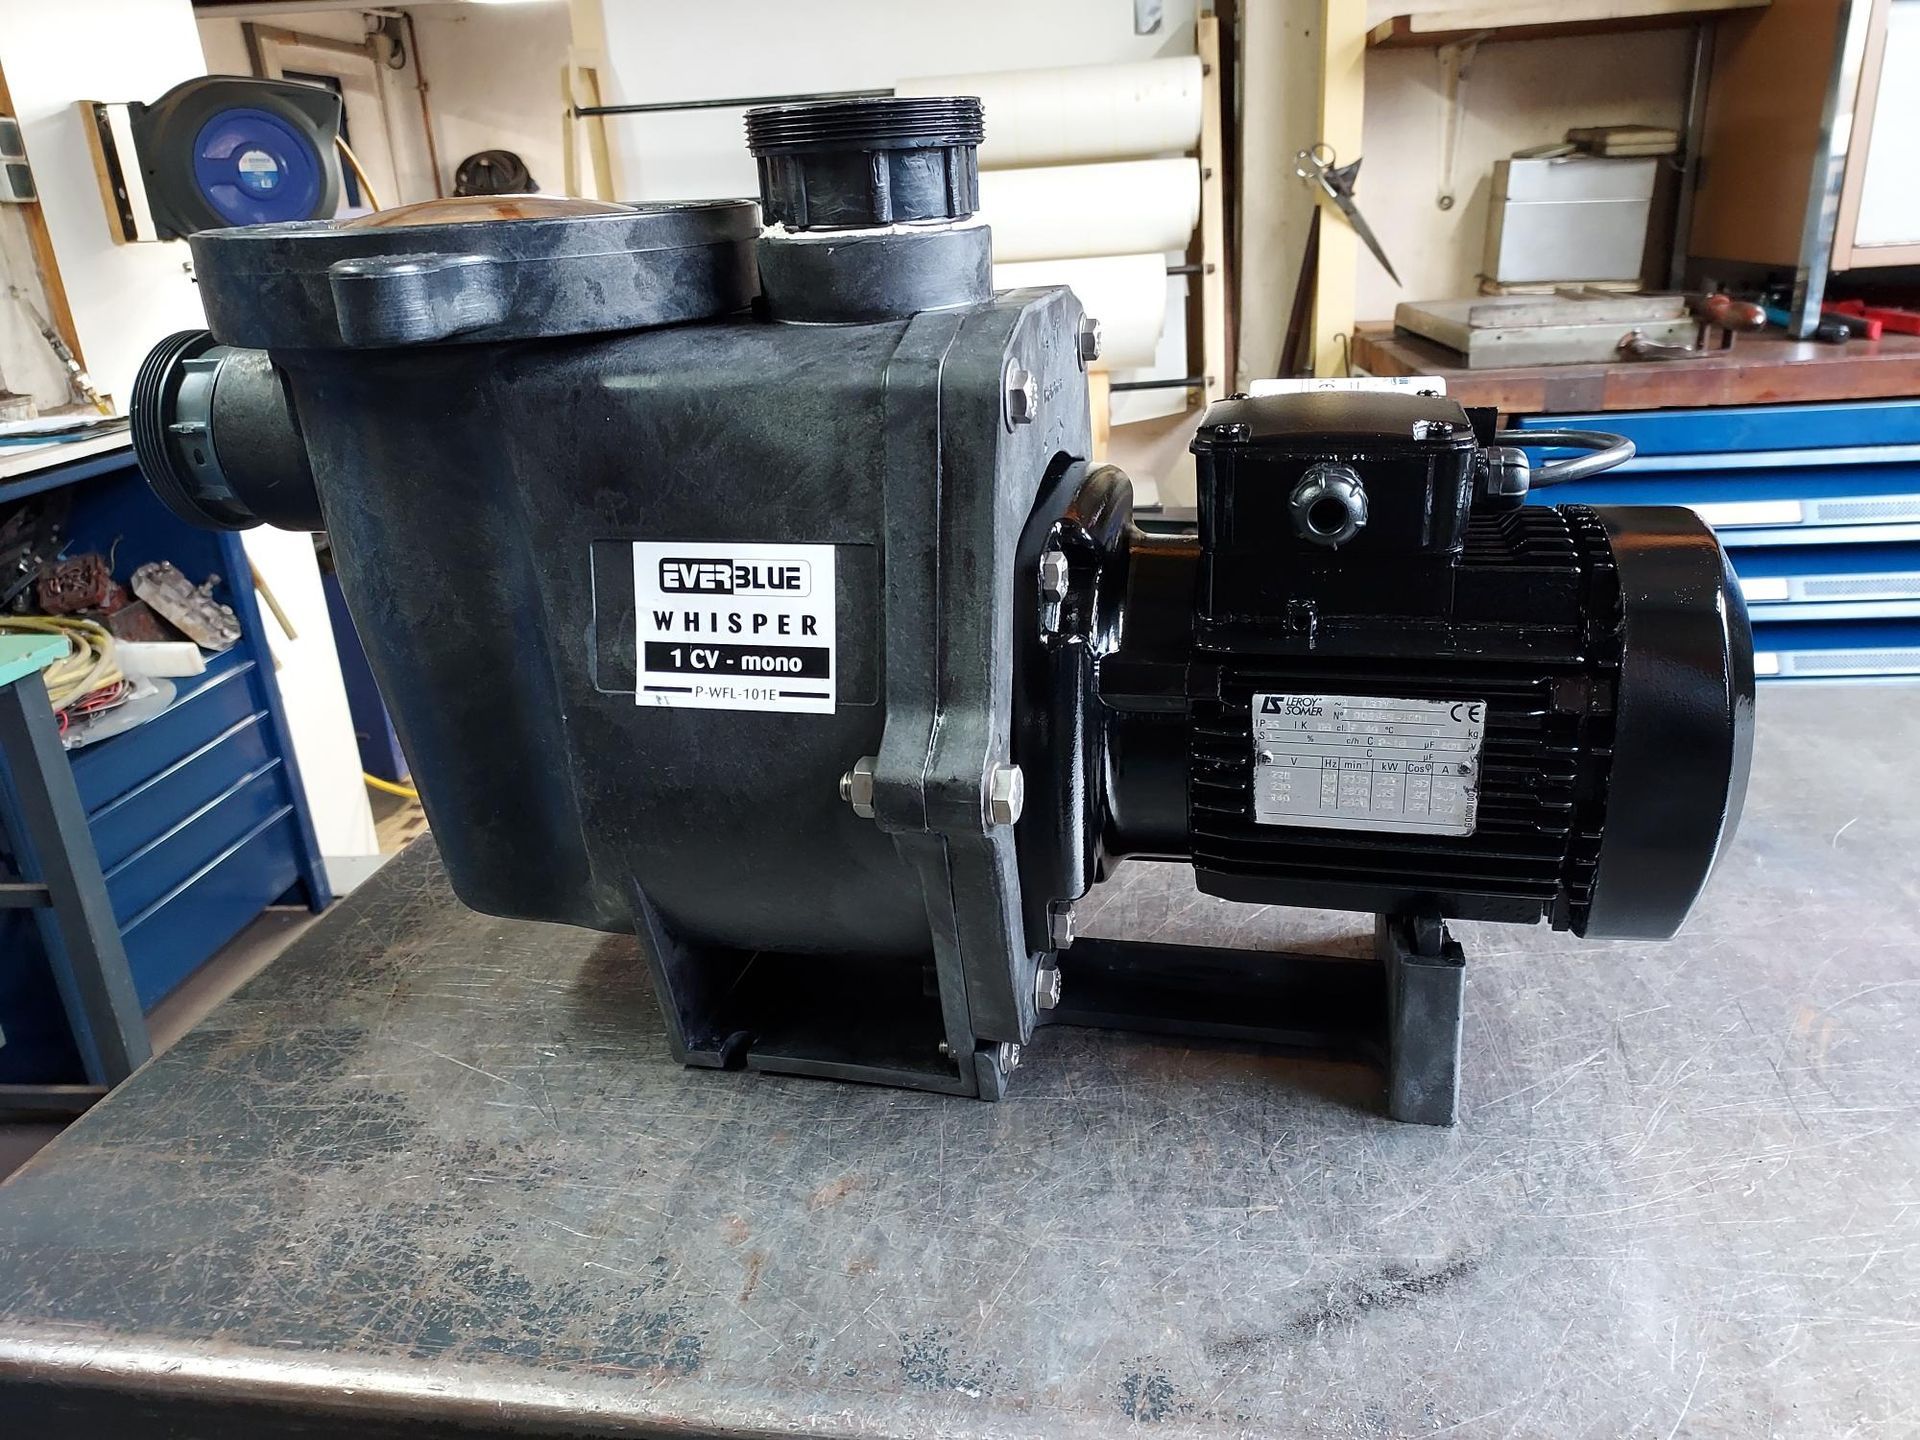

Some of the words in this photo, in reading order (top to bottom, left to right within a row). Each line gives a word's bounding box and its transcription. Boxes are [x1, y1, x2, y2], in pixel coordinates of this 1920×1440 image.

[663, 563, 801, 590] EVERBLUE
[653, 610, 818, 636] WHISPER
[670, 648, 682, 668] 1
[690, 648, 719, 669] CV
[741, 654, 803, 673] mono
[695, 685, 776, 701] P-WFL-101E
[1285, 707, 1323, 716] SOMER
[1367, 737, 1373, 745] C
[1468, 729, 1479, 739] kg
[1366, 749, 1373, 757] C
[1290, 757, 1298, 765] V
[1325, 759, 1337, 768] Hz
[1381, 762, 1399, 771] kW
[1442, 765, 1450, 774] A
